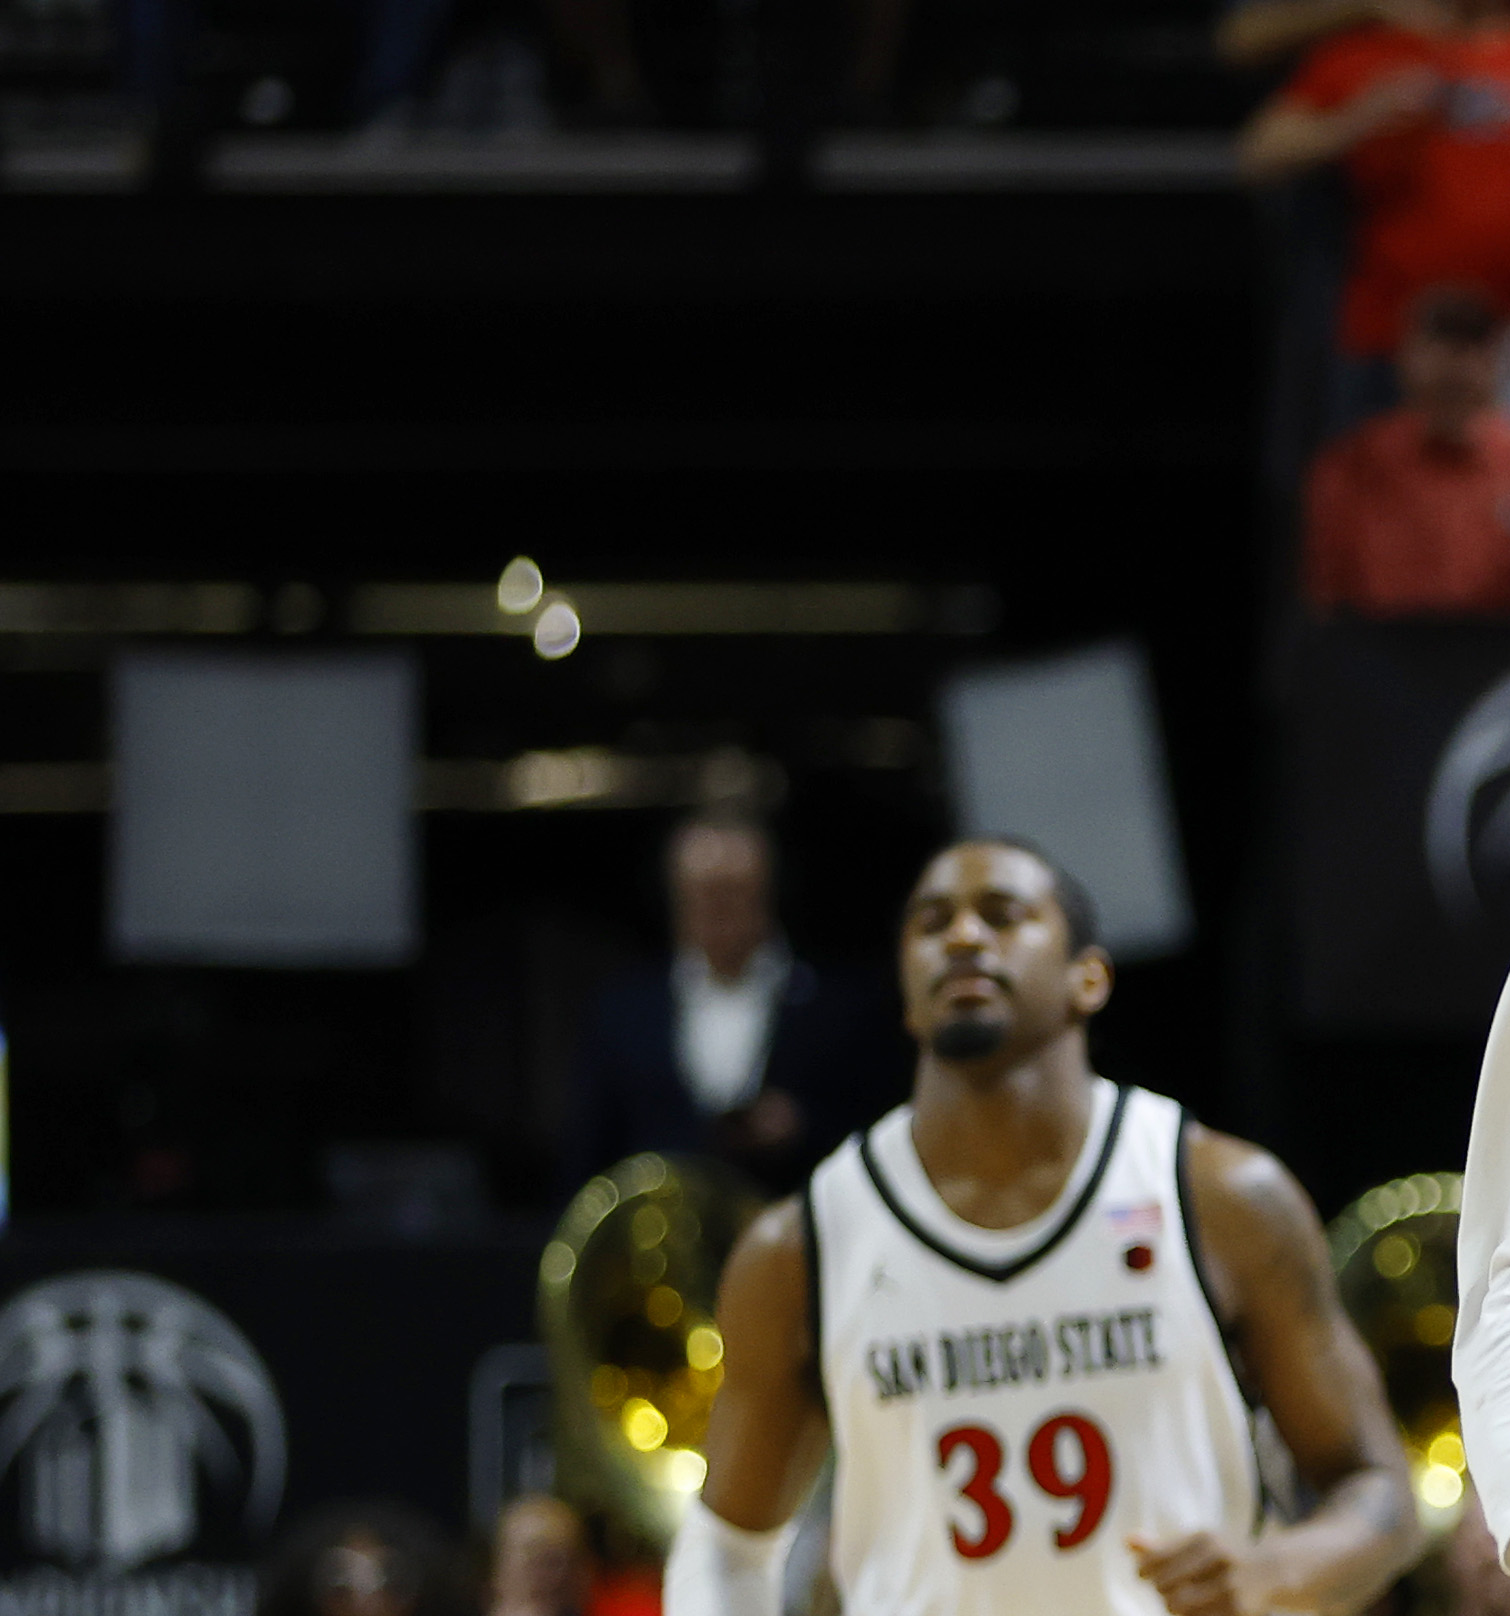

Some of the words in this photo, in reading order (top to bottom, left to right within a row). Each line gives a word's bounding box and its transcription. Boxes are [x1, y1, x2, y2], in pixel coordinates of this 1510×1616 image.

[867, 1334, 928, 1402] SAN
[938, 1319, 1049, 1392] DIEGO
[1055, 1306, 1166, 1377] STATE
[937, 1411, 1113, 1566] 39
